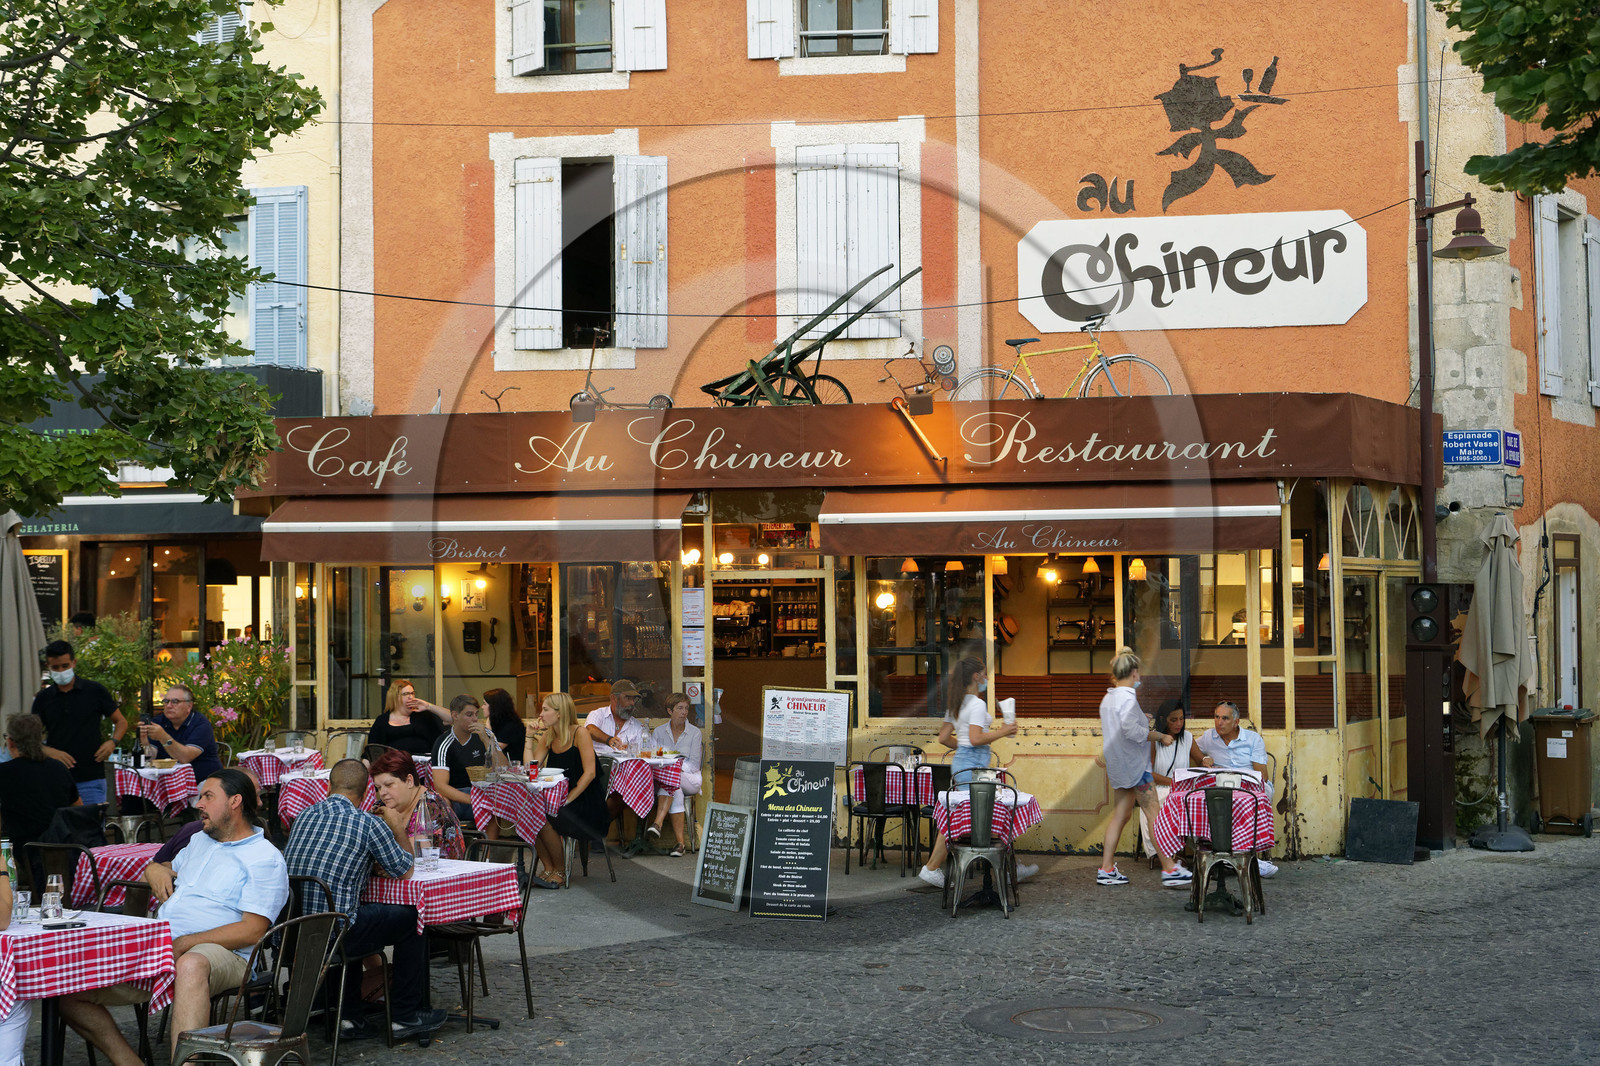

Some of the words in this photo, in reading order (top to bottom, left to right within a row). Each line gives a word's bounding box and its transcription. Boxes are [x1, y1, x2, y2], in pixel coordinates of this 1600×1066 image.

[1076, 172, 1137, 214] au
[1041, 228, 1348, 323] Chineur
[513, 421, 615, 474] Au
[626, 416, 852, 470] Chineur
[959, 411, 1278, 465] Restaurant
[1448, 432, 1493, 440] Esplanade
[1473, 440, 1499, 448] Vasse
[286, 424, 413, 490] Café
[19, 523, 79, 534] GELATERIA
[971, 526, 1018, 550] Au
[1021, 524, 1122, 549] Chineur
[427, 536, 507, 559] Bistrot
[786, 702, 826, 711] CHINEUR
[795, 769, 805, 778] au
[787, 776, 830, 793] Chineur
[768, 803, 784, 811] Menu
[796, 804, 823, 812] Chineurs
